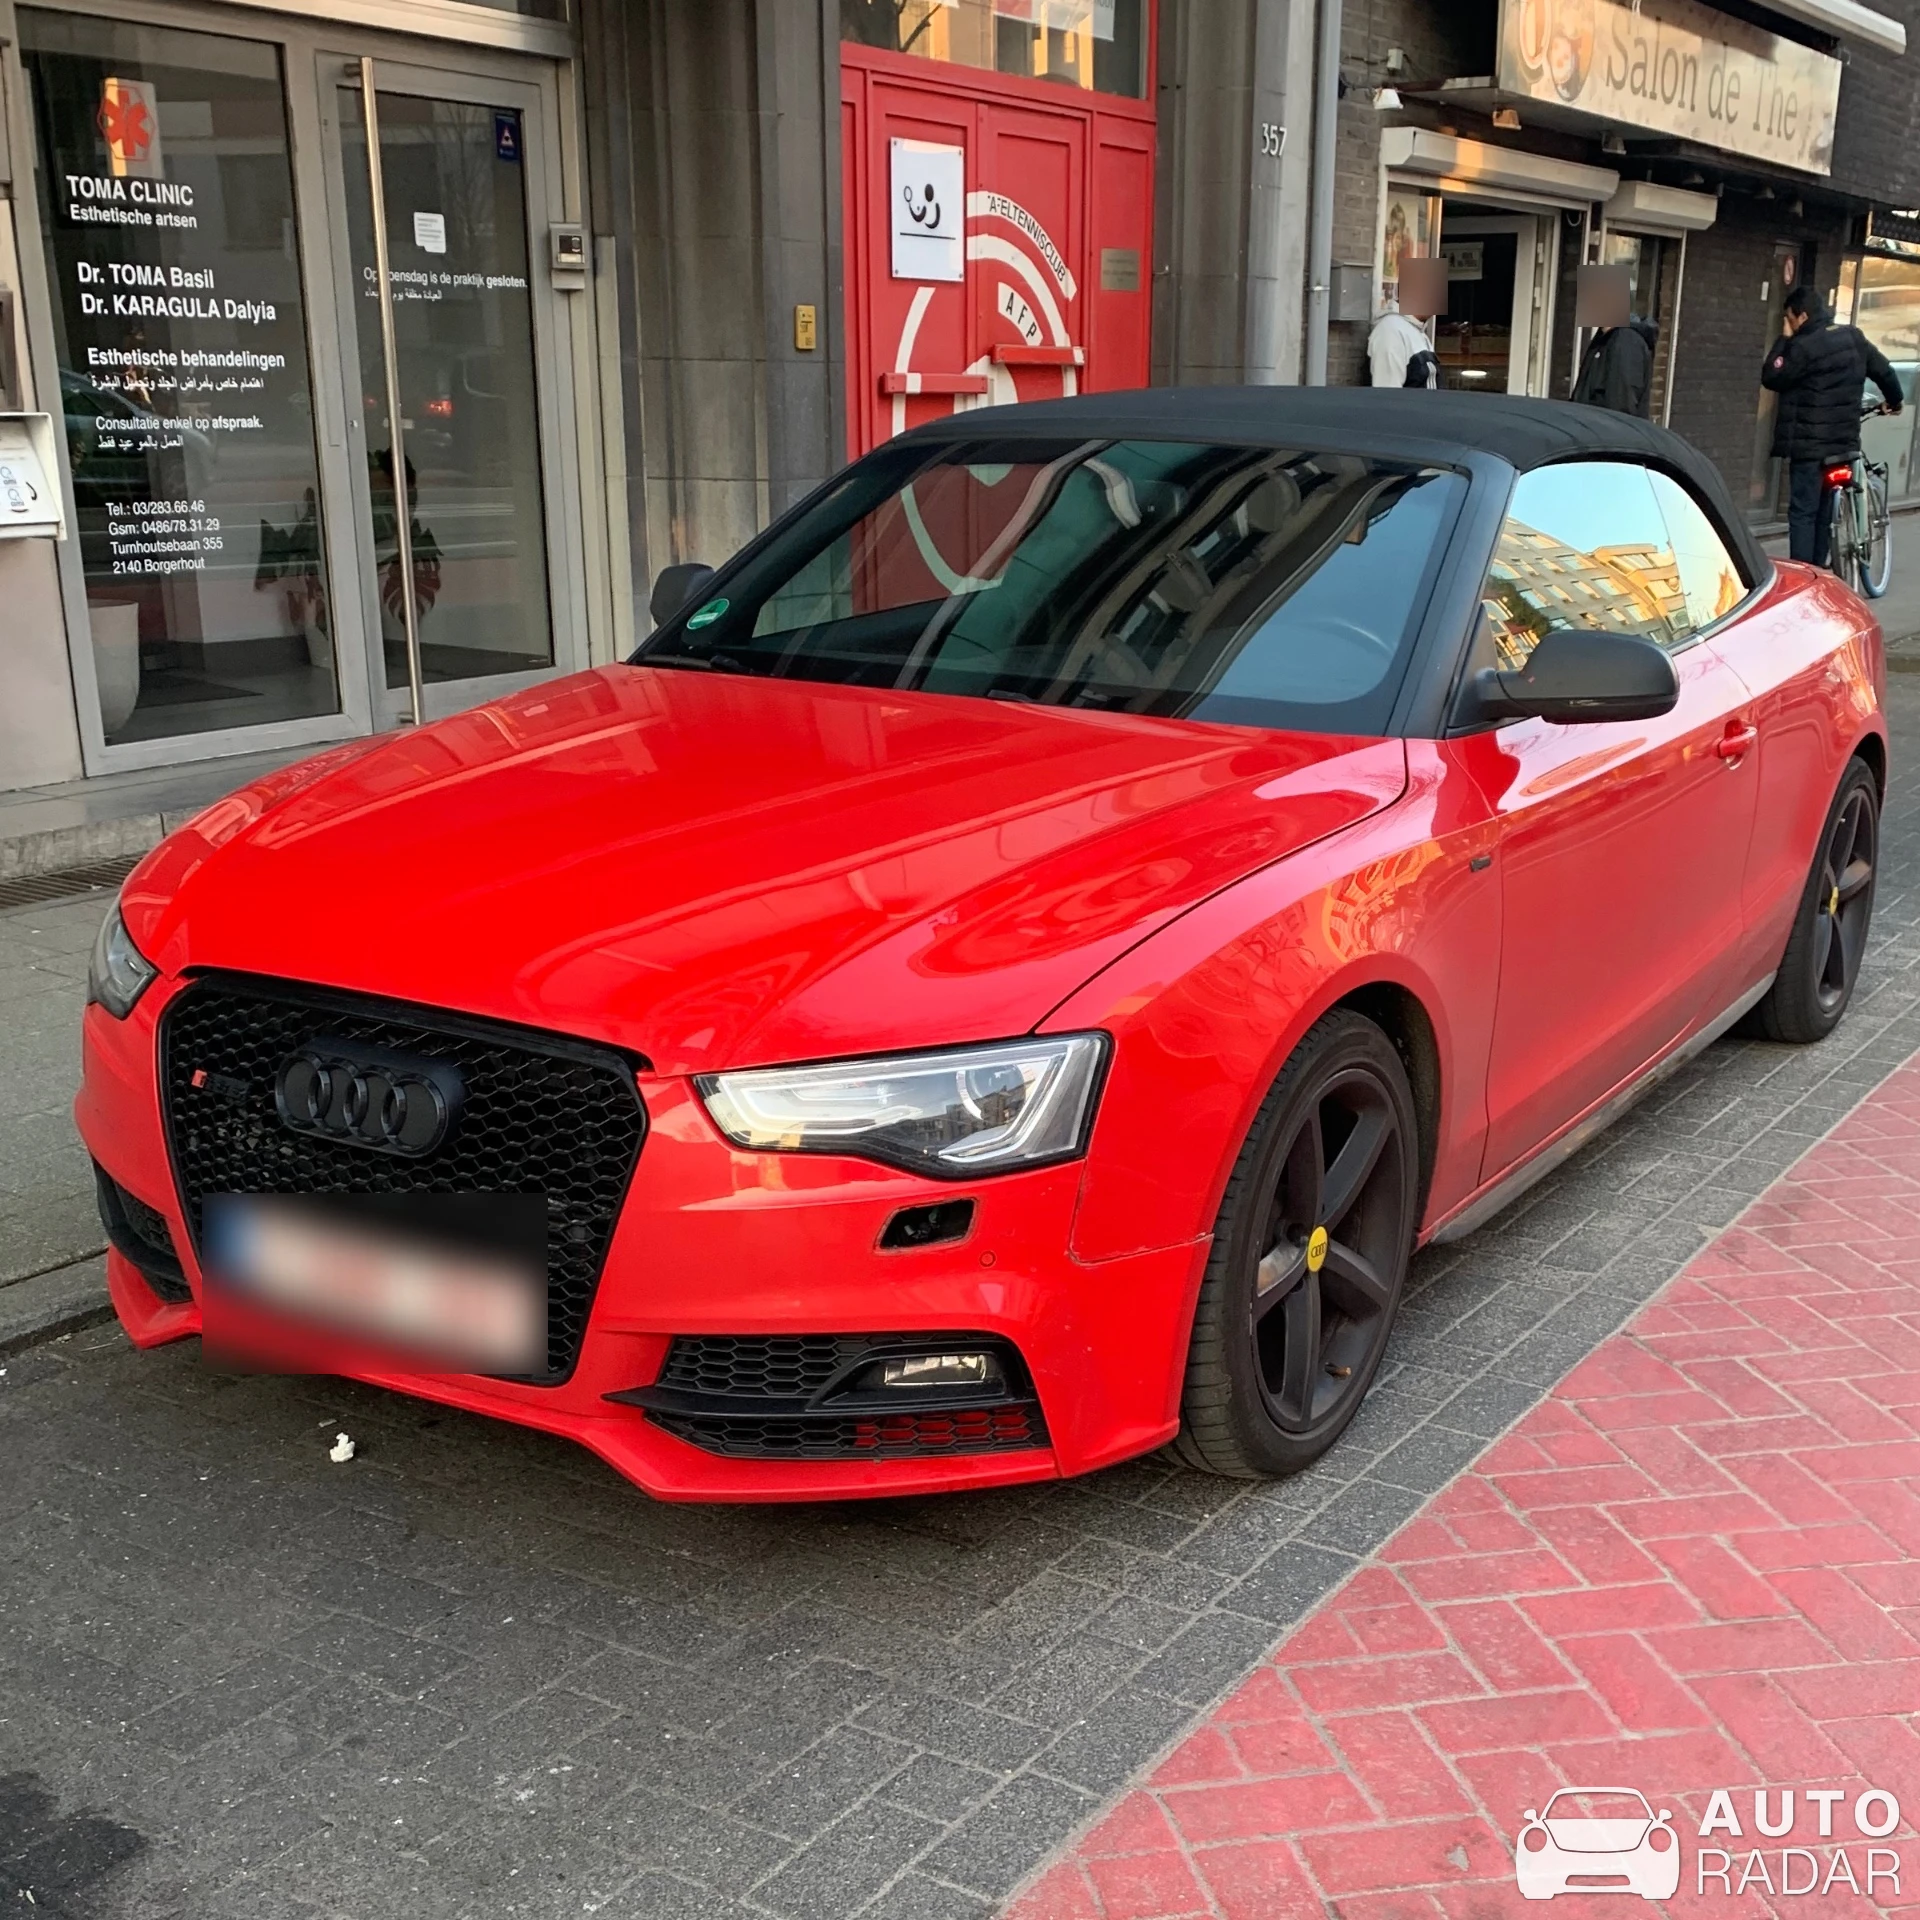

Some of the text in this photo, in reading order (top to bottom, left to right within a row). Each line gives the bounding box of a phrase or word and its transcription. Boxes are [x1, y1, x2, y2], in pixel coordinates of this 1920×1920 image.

[1606, 11, 1700, 112] Salon
[1708, 41, 1741, 124] de
[1261, 122, 1287, 156] 357
[66, 175, 194, 206] TOMA CLINIC
[70, 203, 197, 228] Esthetische artsen
[77, 261, 214, 289] Dr. TOMA Basil
[387, 269, 429, 287] oensdag
[429, 270, 438, 284] is
[440, 271, 451, 285] de
[453, 272, 486, 288] praktijk
[486, 275, 528, 289] gesloten.
[81, 293, 276, 325] Dr. KARAGULA Dalyia
[87, 347, 285, 371] Esthetische behandelingen
[91, 375, 121, 391] البشرة
[157, 375, 178, 392] الجلد
[180, 374, 214, 392] بأمراض
[215, 376, 238, 391] خاص
[95, 415, 264, 432] Consultatie enkel op afspraak.
[98, 434, 116, 449] فقط
[160, 434, 184, 450] العمل
[105, 499, 205, 516] Tel.: 03/283.66.46
[108, 518, 220, 536] Gsm: 0486/78.31.29
[110, 536, 223, 555] Turnhoutsebaan 355
[112, 556, 206, 575] 2140 Borgerhout
